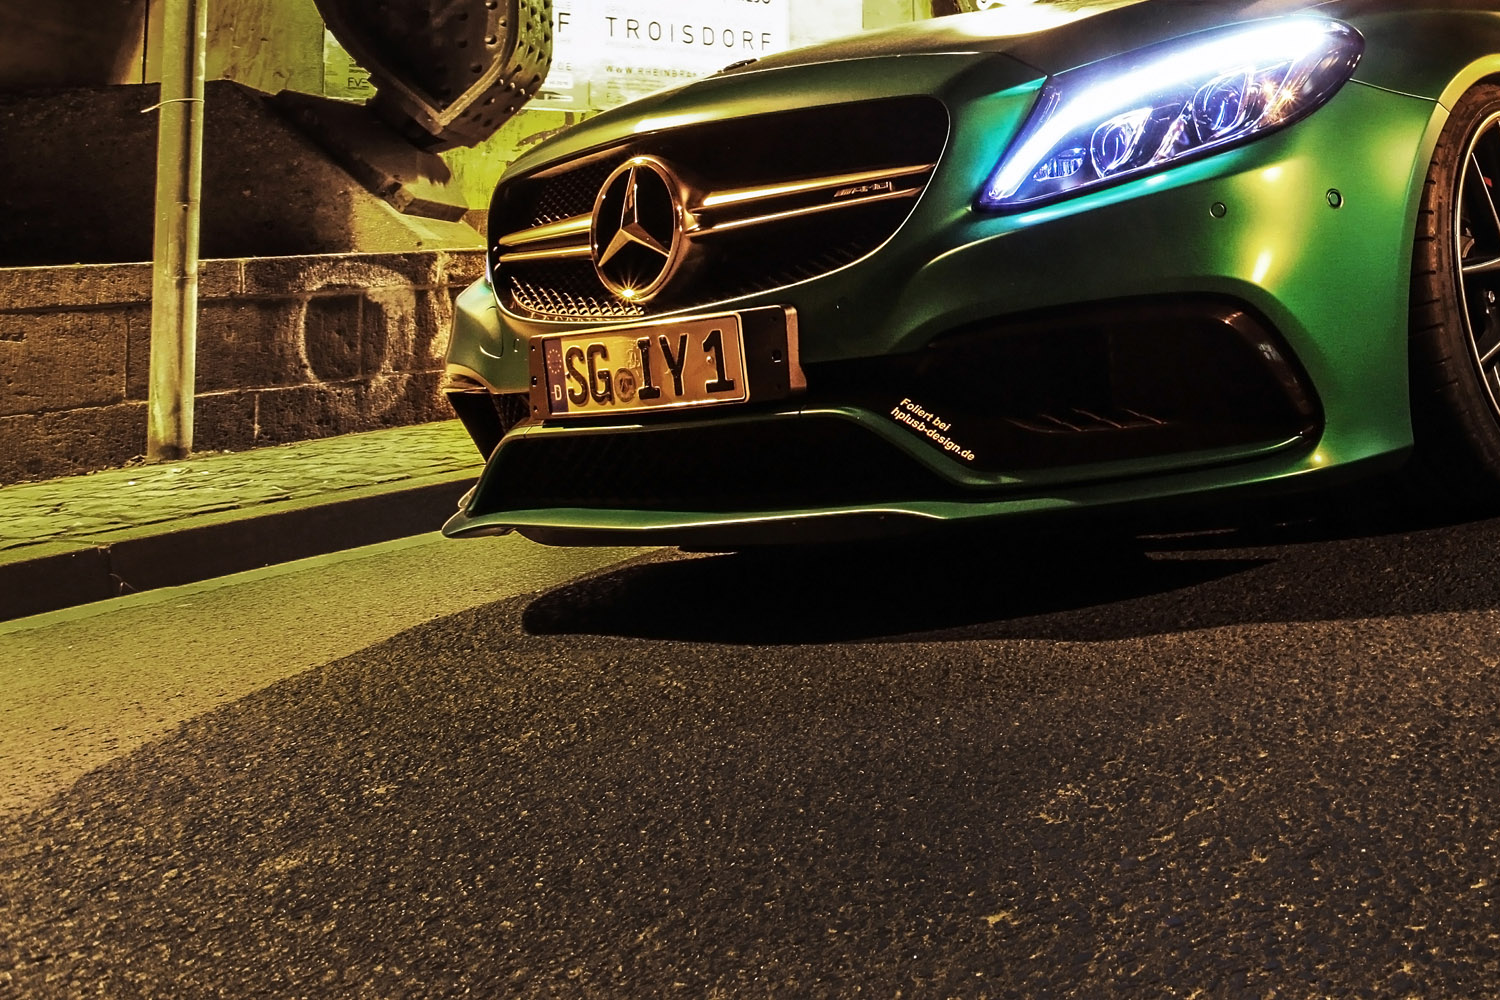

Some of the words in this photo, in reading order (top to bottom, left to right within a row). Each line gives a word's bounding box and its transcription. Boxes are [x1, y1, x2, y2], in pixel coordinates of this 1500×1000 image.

[604, 16, 773, 51] TROISDORF
[565, 342, 614, 406] SG
[702, 329, 735, 394] 1
[890, 406, 975, 461] hplusb-design.de
[900, 397, 934, 422] Foliert
[931, 416, 952, 432] bei
